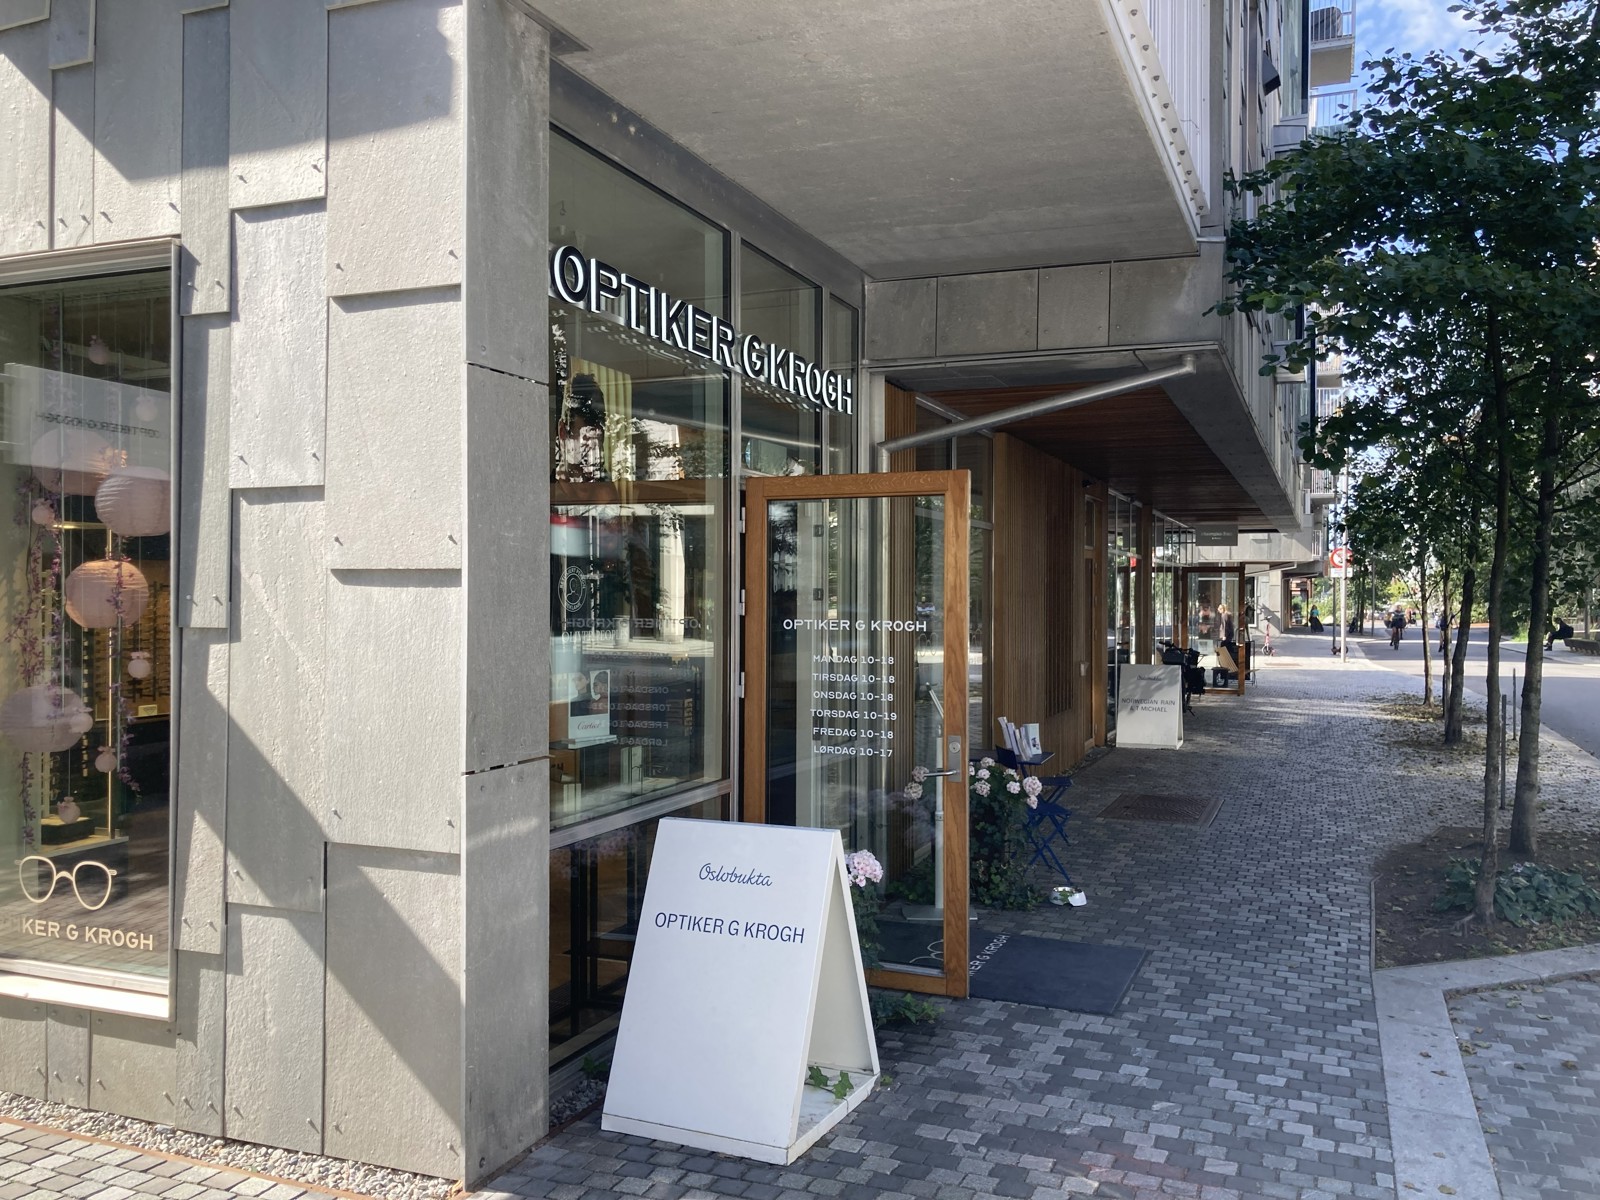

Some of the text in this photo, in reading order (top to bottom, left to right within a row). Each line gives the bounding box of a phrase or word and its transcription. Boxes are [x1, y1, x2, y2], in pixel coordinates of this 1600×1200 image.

[552, 245, 853, 415] OPTIKER G KROGH
[782, 619, 927, 632] OPTIKER G KROGH
[813, 655, 894, 665] MANDAG 10-18
[812, 673, 895, 684] TIRSDAG 10-18
[813, 691, 894, 702] ONSDAG 10-18
[1121, 697, 1158, 705] NORWEGIAN
[810, 709, 897, 720] TORSDAG 10-19
[577, 720, 601, 731] Cartier
[813, 727, 894, 739] FREDAG 10-18
[813, 745, 893, 757] LØRDAG 10-17
[698, 862, 773, 887] Oslobukta
[18, 917, 153, 951] KER G KROGH
[655, 912, 805, 944] OPTIKER G KROGH
